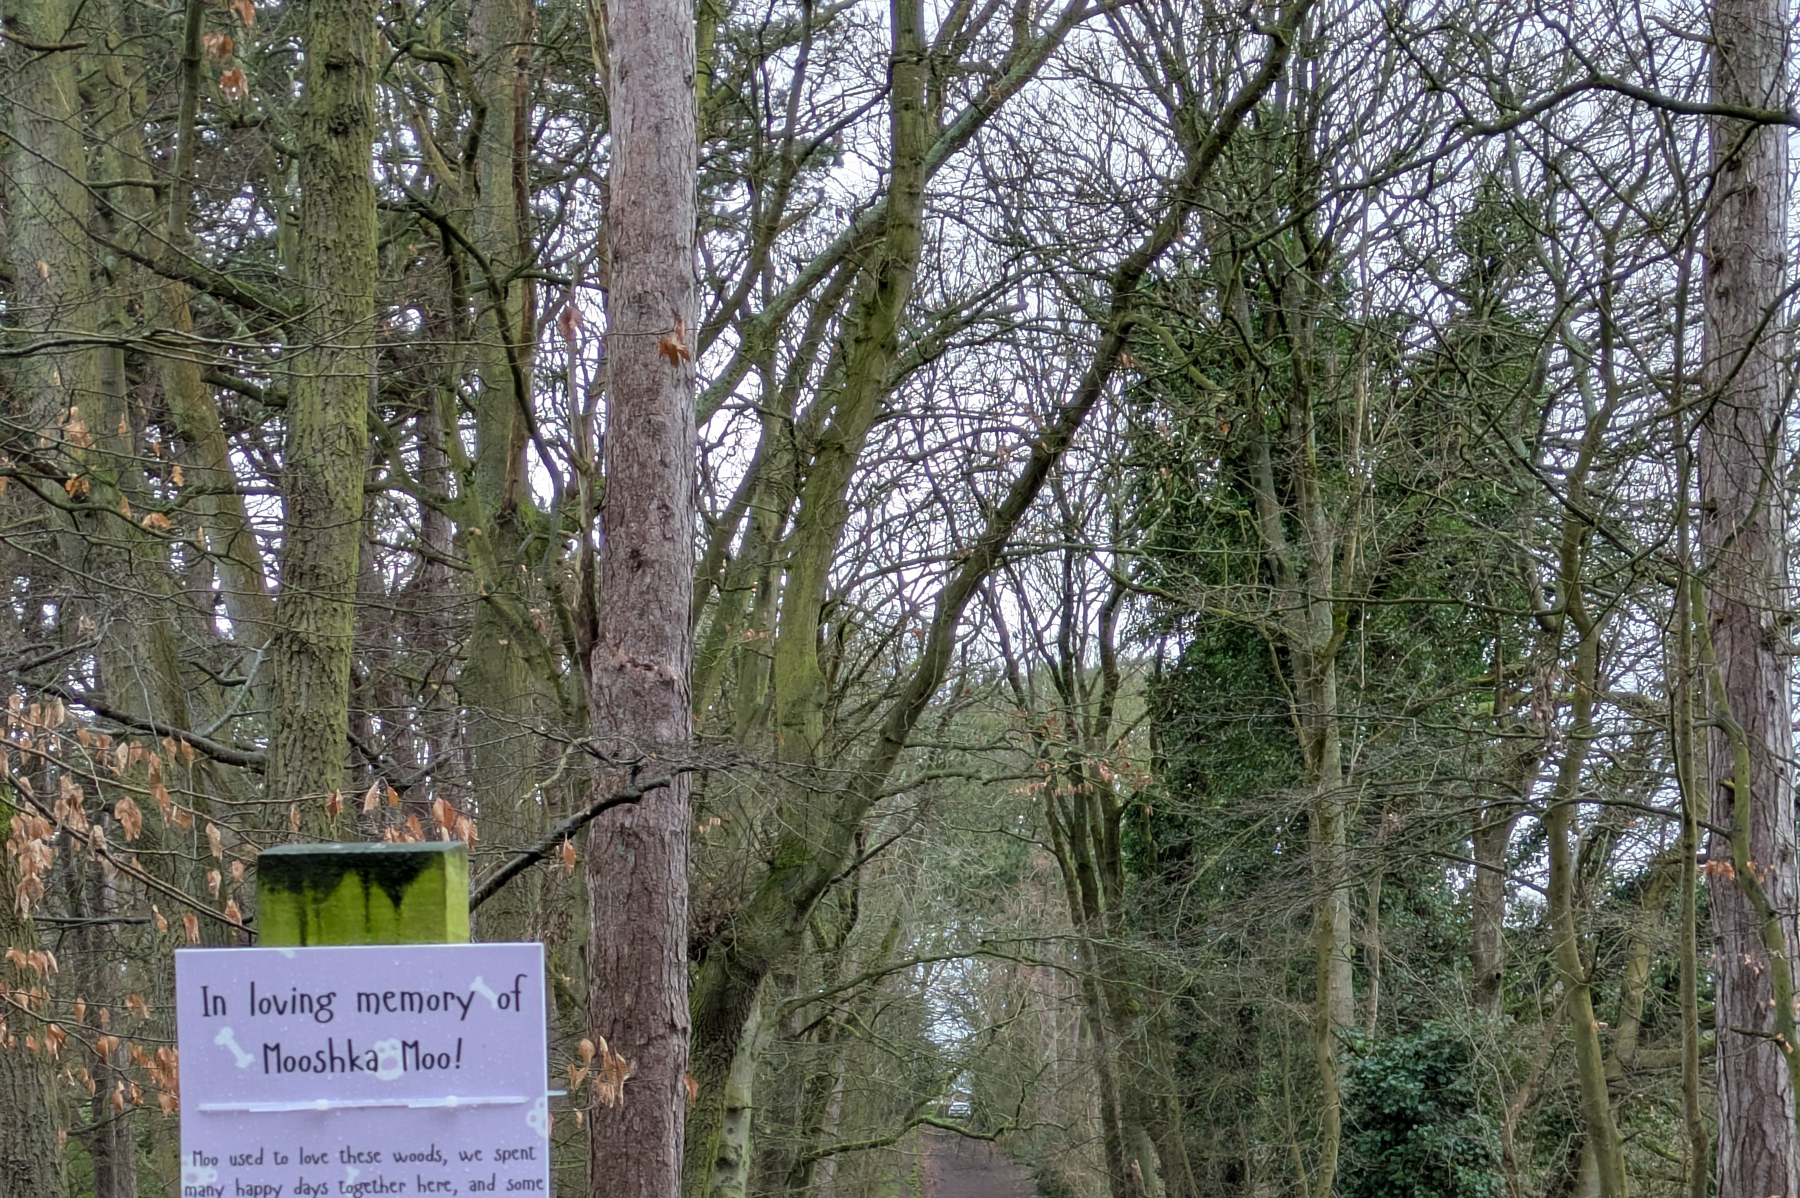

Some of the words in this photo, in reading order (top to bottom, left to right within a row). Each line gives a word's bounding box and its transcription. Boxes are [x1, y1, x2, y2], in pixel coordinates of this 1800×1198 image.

[200, 985, 227, 1018] In
[249, 980, 338, 1024] loving
[356, 990, 476, 1022] memory
[497, 973, 528, 1013] of
[262, 1036, 379, 1075] Mooshka
[401, 1036, 463, 1073] Moo!
[192, 1149, 219, 1167] Moo
[229, 1146, 264, 1167] used
[272, 1151, 289, 1166] to
[299, 1146, 329, 1166] love
[339, 1144, 382, 1165] these
[392, 1143, 448, 1167] woods,
[458, 1149, 483, 1163] we
[493, 1146, 537, 1165] spent
[416, 1173, 458, 1197] here,
[468, 1172, 496, 1193] and
[505, 1178, 544, 1192] some
